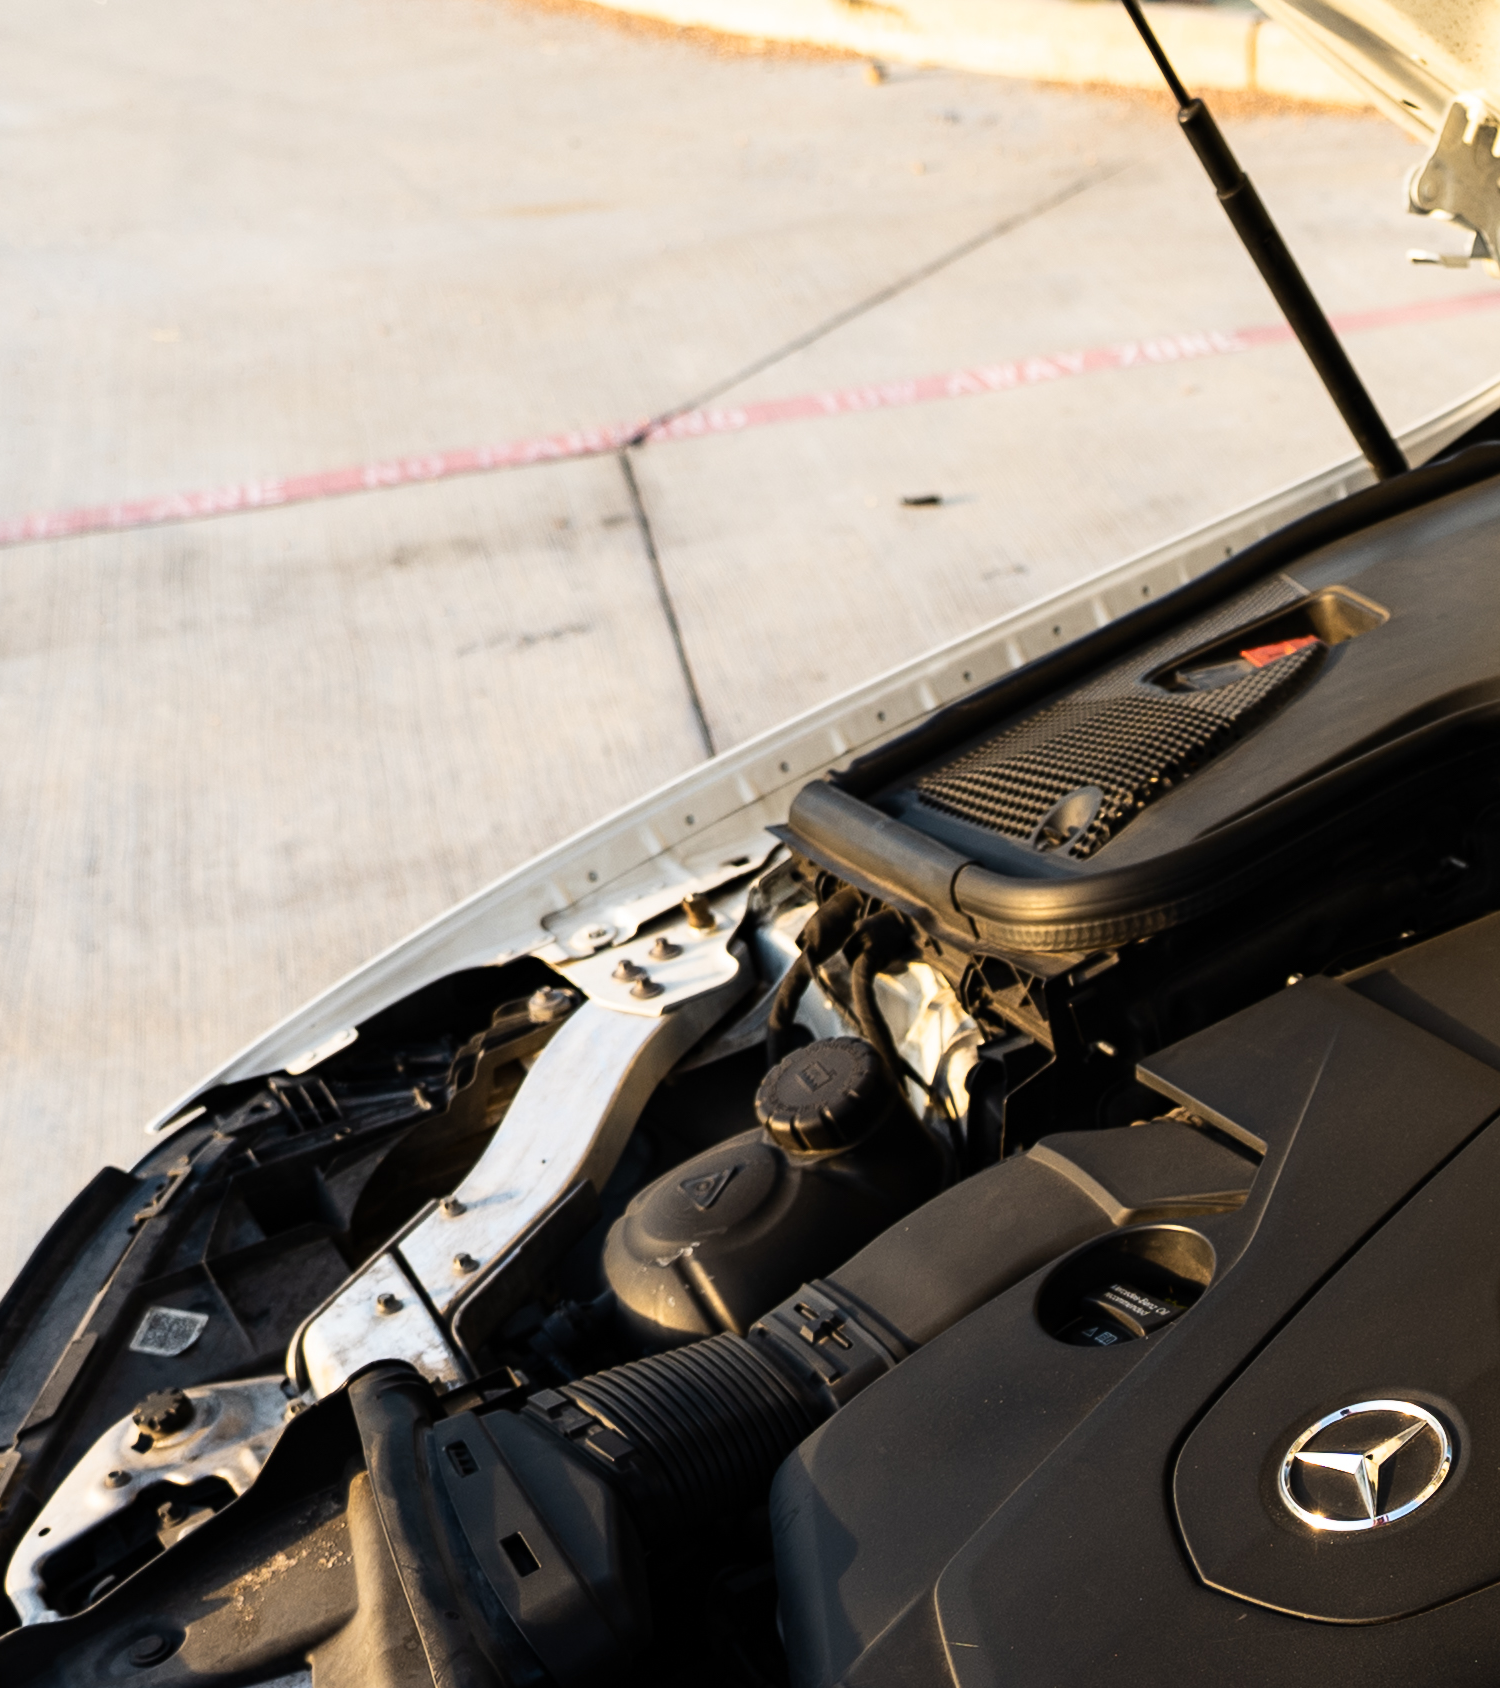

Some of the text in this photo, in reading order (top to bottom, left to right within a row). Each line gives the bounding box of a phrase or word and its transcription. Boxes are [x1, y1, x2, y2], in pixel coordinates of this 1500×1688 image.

[363, 453, 446, 488] NO
[813, 380, 919, 415] TOW
[944, 348, 1090, 398] AWAY
[1113, 328, 1247, 369] ZONE
